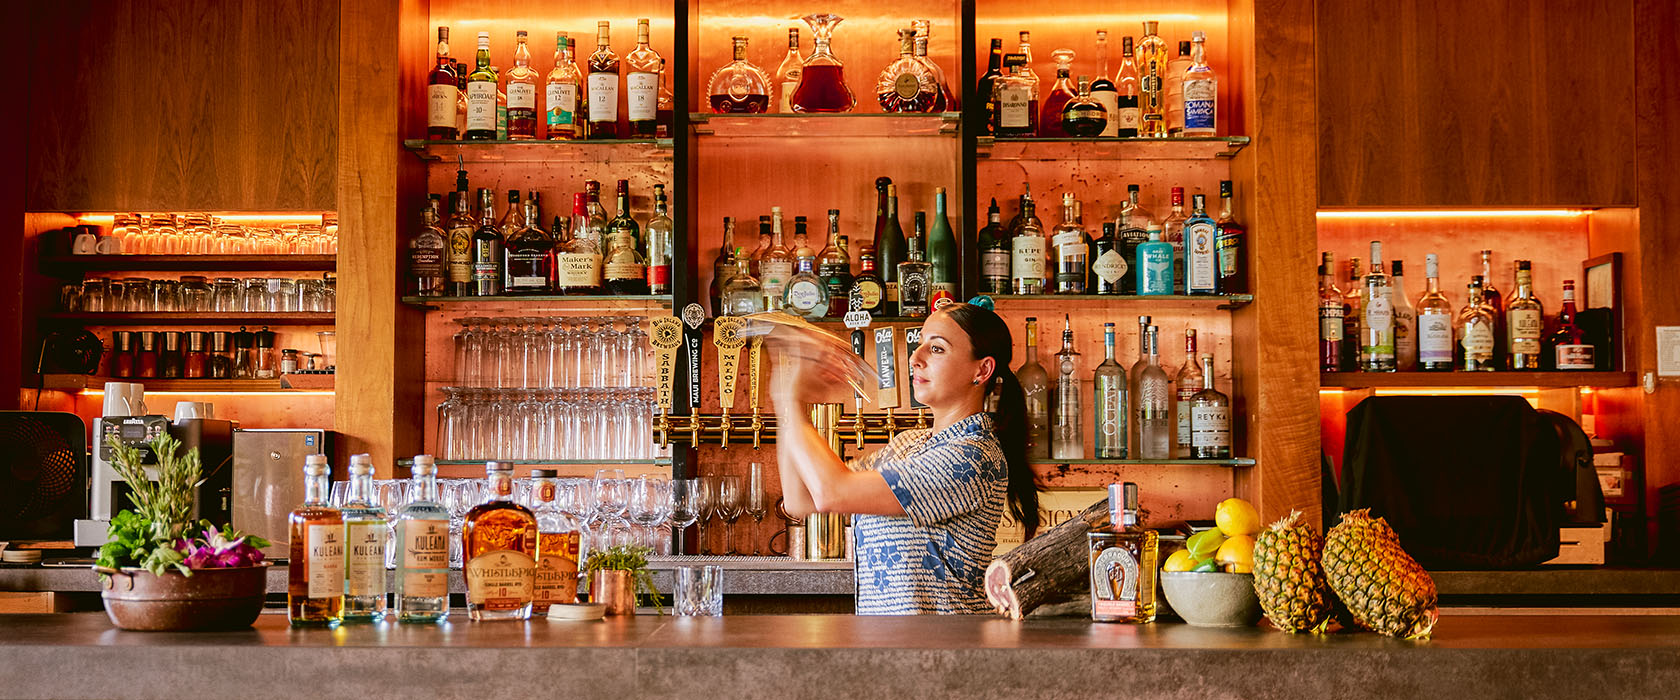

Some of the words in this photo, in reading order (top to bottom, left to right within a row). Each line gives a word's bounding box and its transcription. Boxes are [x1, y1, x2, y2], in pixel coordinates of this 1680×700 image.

[562, 255, 593, 264] Maker's
[845, 312, 870, 322] ALOHA
[691, 349, 699, 383] BREWING
[723, 354, 735, 393] MALOLO
[881, 359, 891, 388] KIAWE
[660, 353, 671, 405] SABBATH
[692, 384, 700, 404] MAUI
[1197, 413, 1226, 421] REYKA
[415, 535, 446, 551] KULEANA
[498, 588, 508, 597] 10
[541, 590, 550, 600] 10
